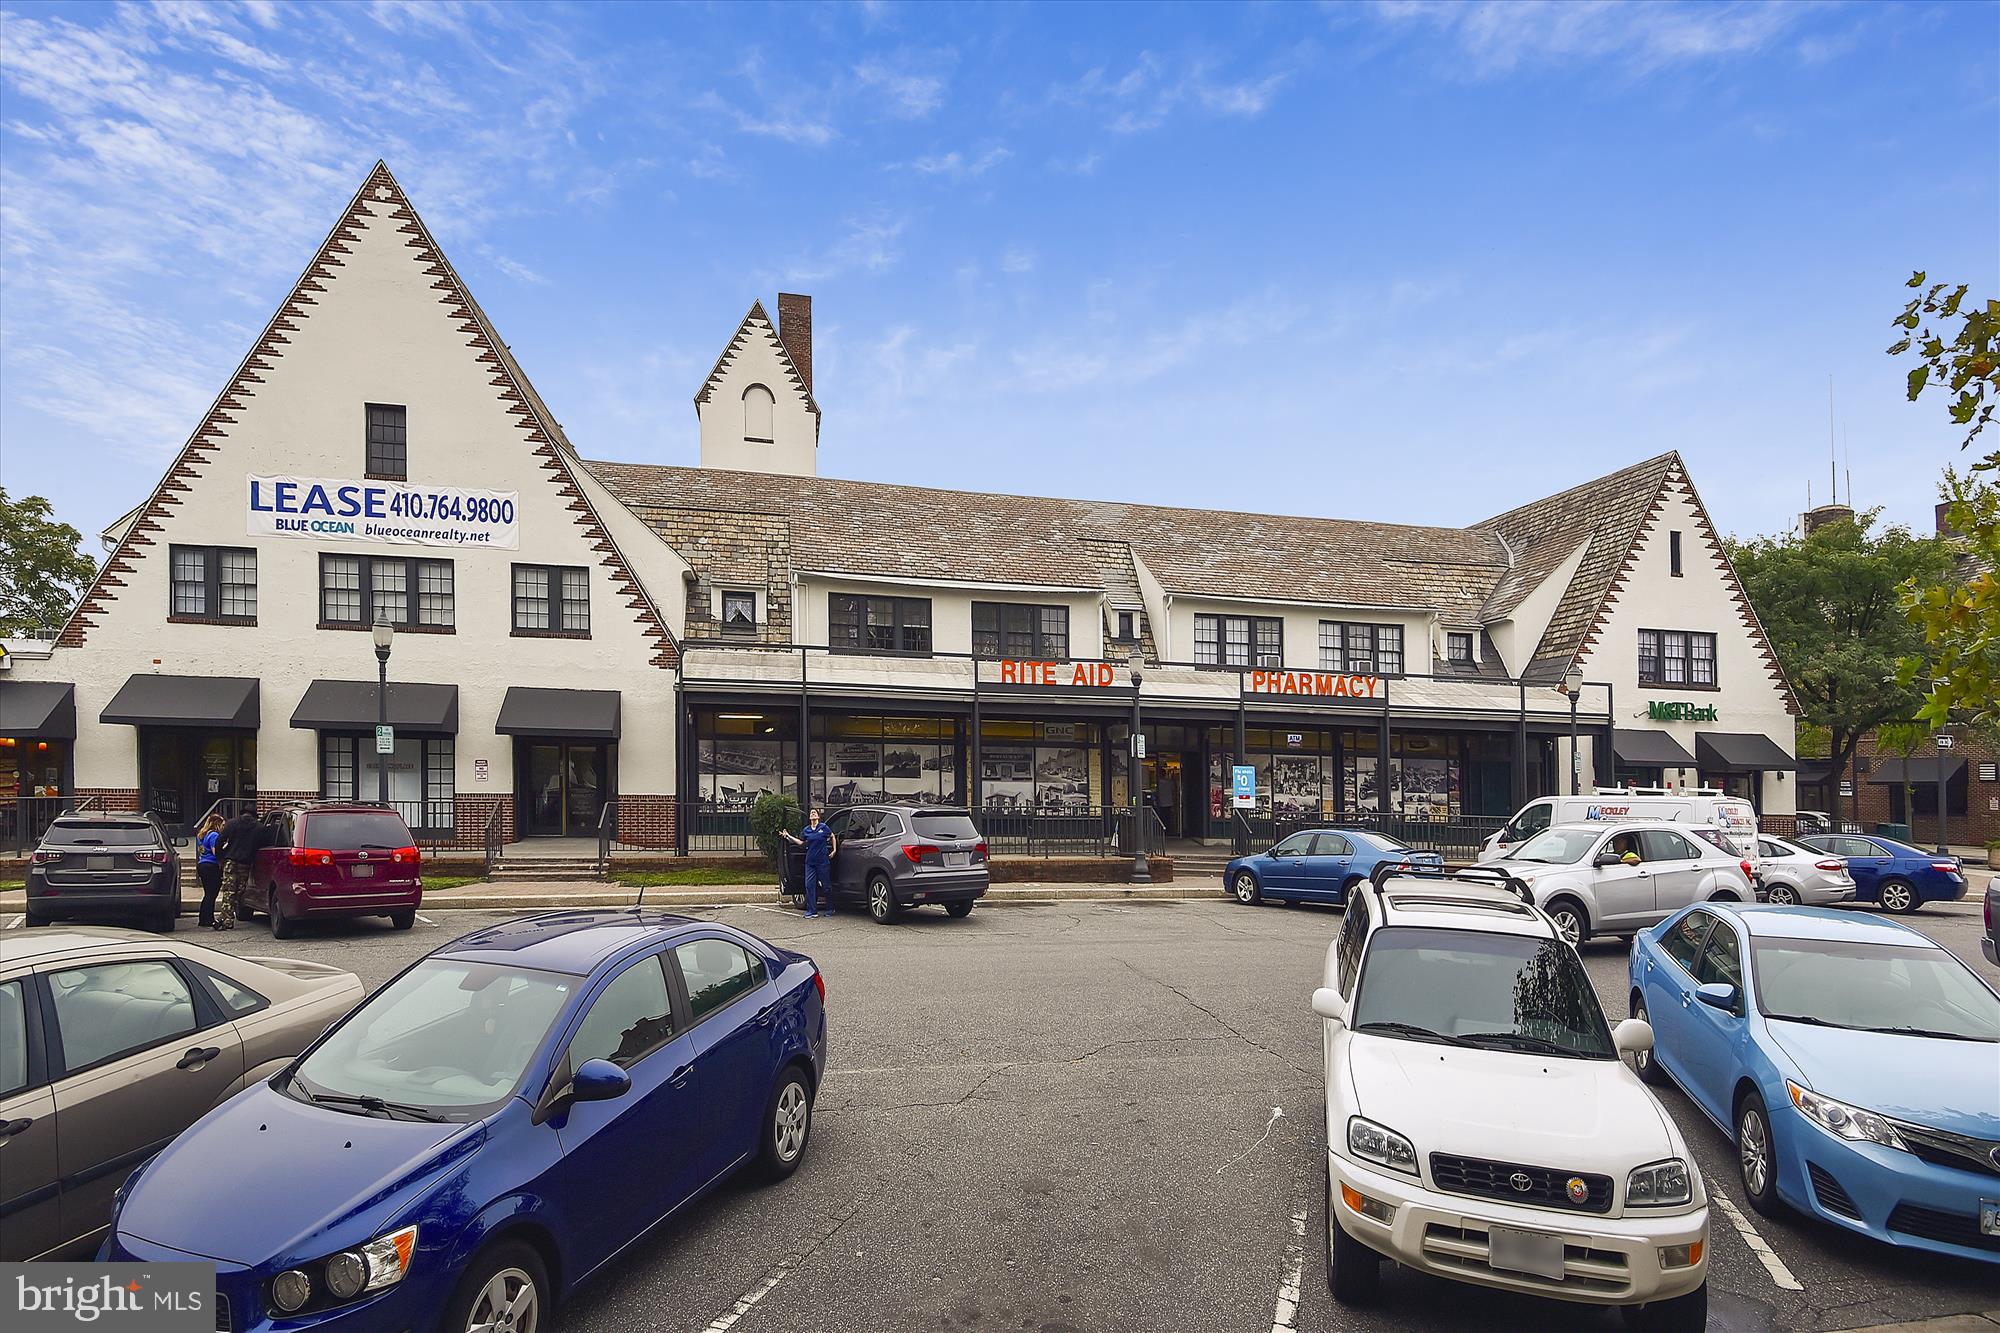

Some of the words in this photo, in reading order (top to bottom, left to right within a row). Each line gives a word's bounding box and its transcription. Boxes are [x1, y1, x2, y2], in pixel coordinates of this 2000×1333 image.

[250, 480, 386, 519] LEASE
[390, 491, 514, 525] 410.764.9800
[276, 518, 309, 532] BLUE
[310, 520, 355, 534] OCEAN
[364, 523, 491, 544] blueoceanrealty.net
[1001, 659, 1057, 686] RITE
[1072, 663, 1114, 688] AID
[1252, 670, 1378, 698] PHARMACY
[1648, 700, 1683, 721] M&T
[1684, 702, 1719, 722] Bank
[1045, 726, 1074, 735] GNC
[1585, 804, 1630, 820] MECKLEY
